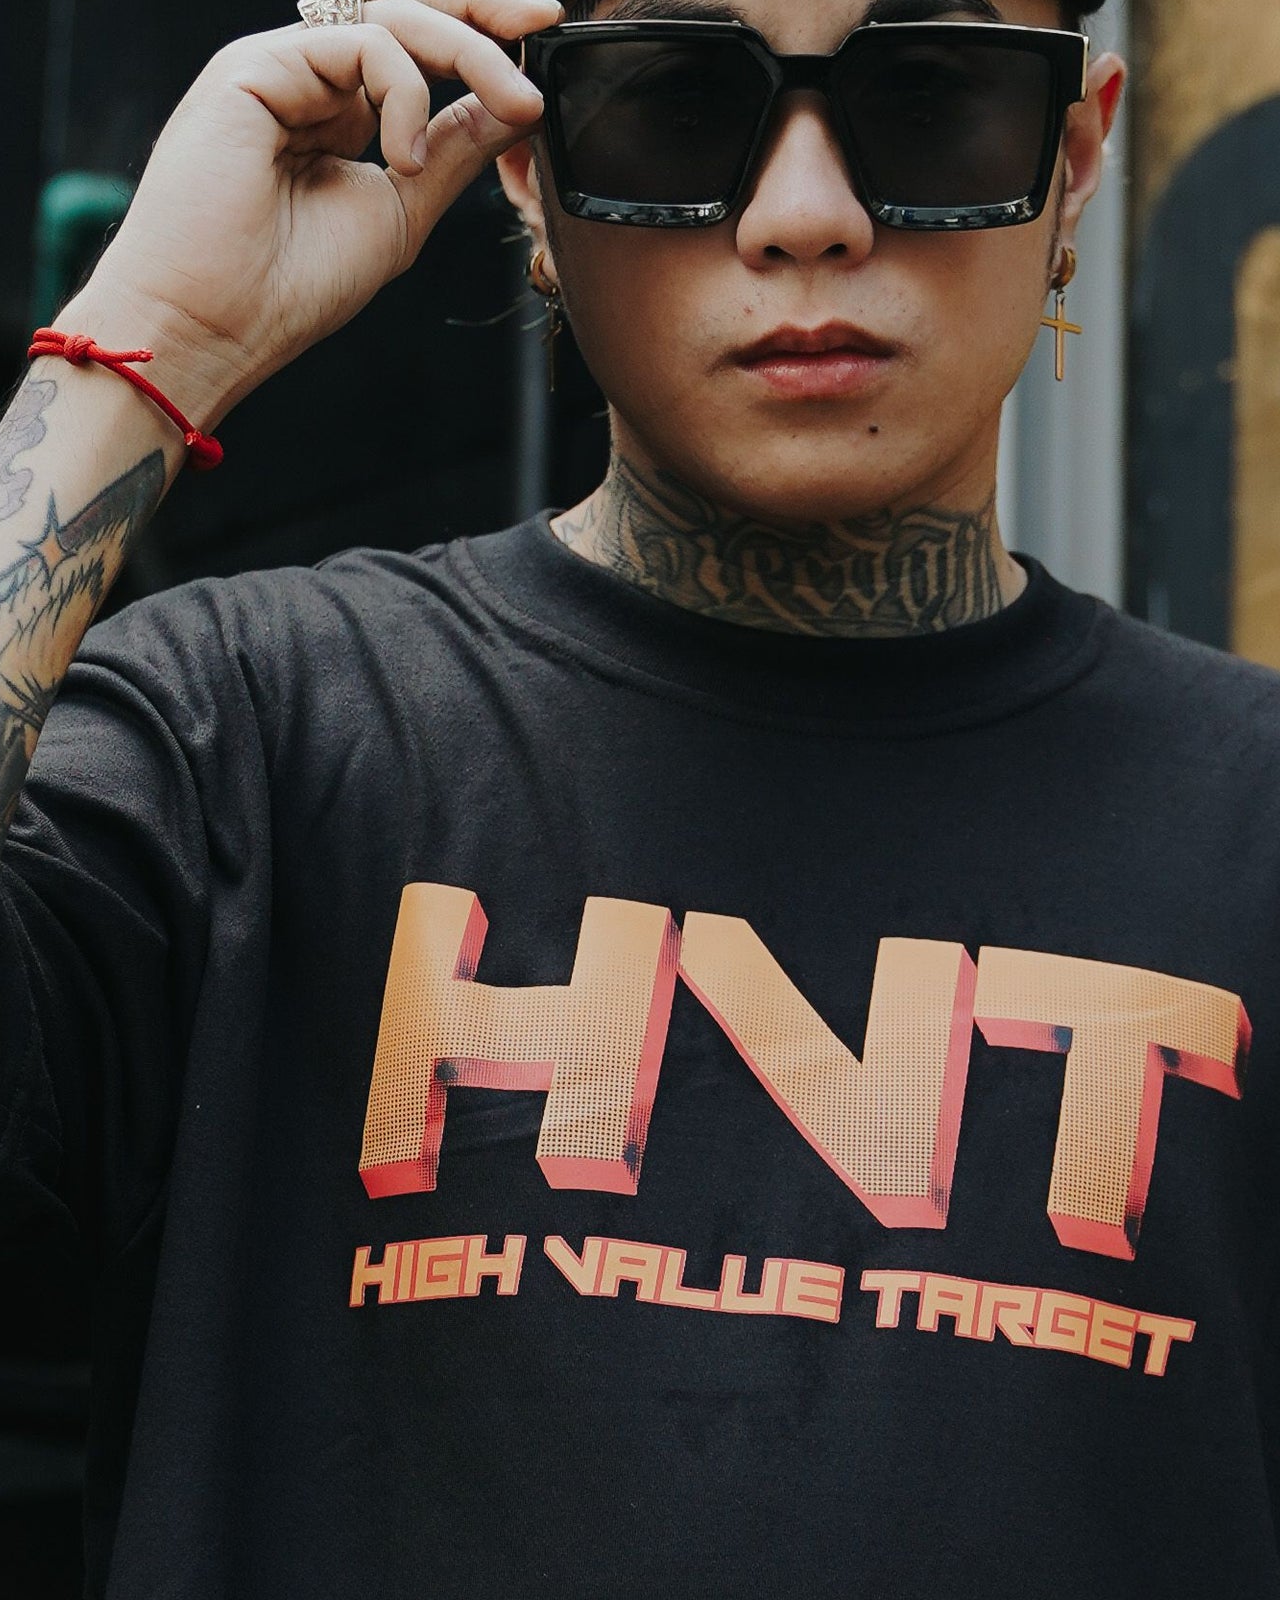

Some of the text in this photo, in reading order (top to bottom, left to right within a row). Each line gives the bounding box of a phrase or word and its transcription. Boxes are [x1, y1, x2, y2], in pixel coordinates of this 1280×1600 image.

[358, 882, 1253, 1260] HNT
[349, 1234, 1196, 1377] HIGH VALUE TARGET
